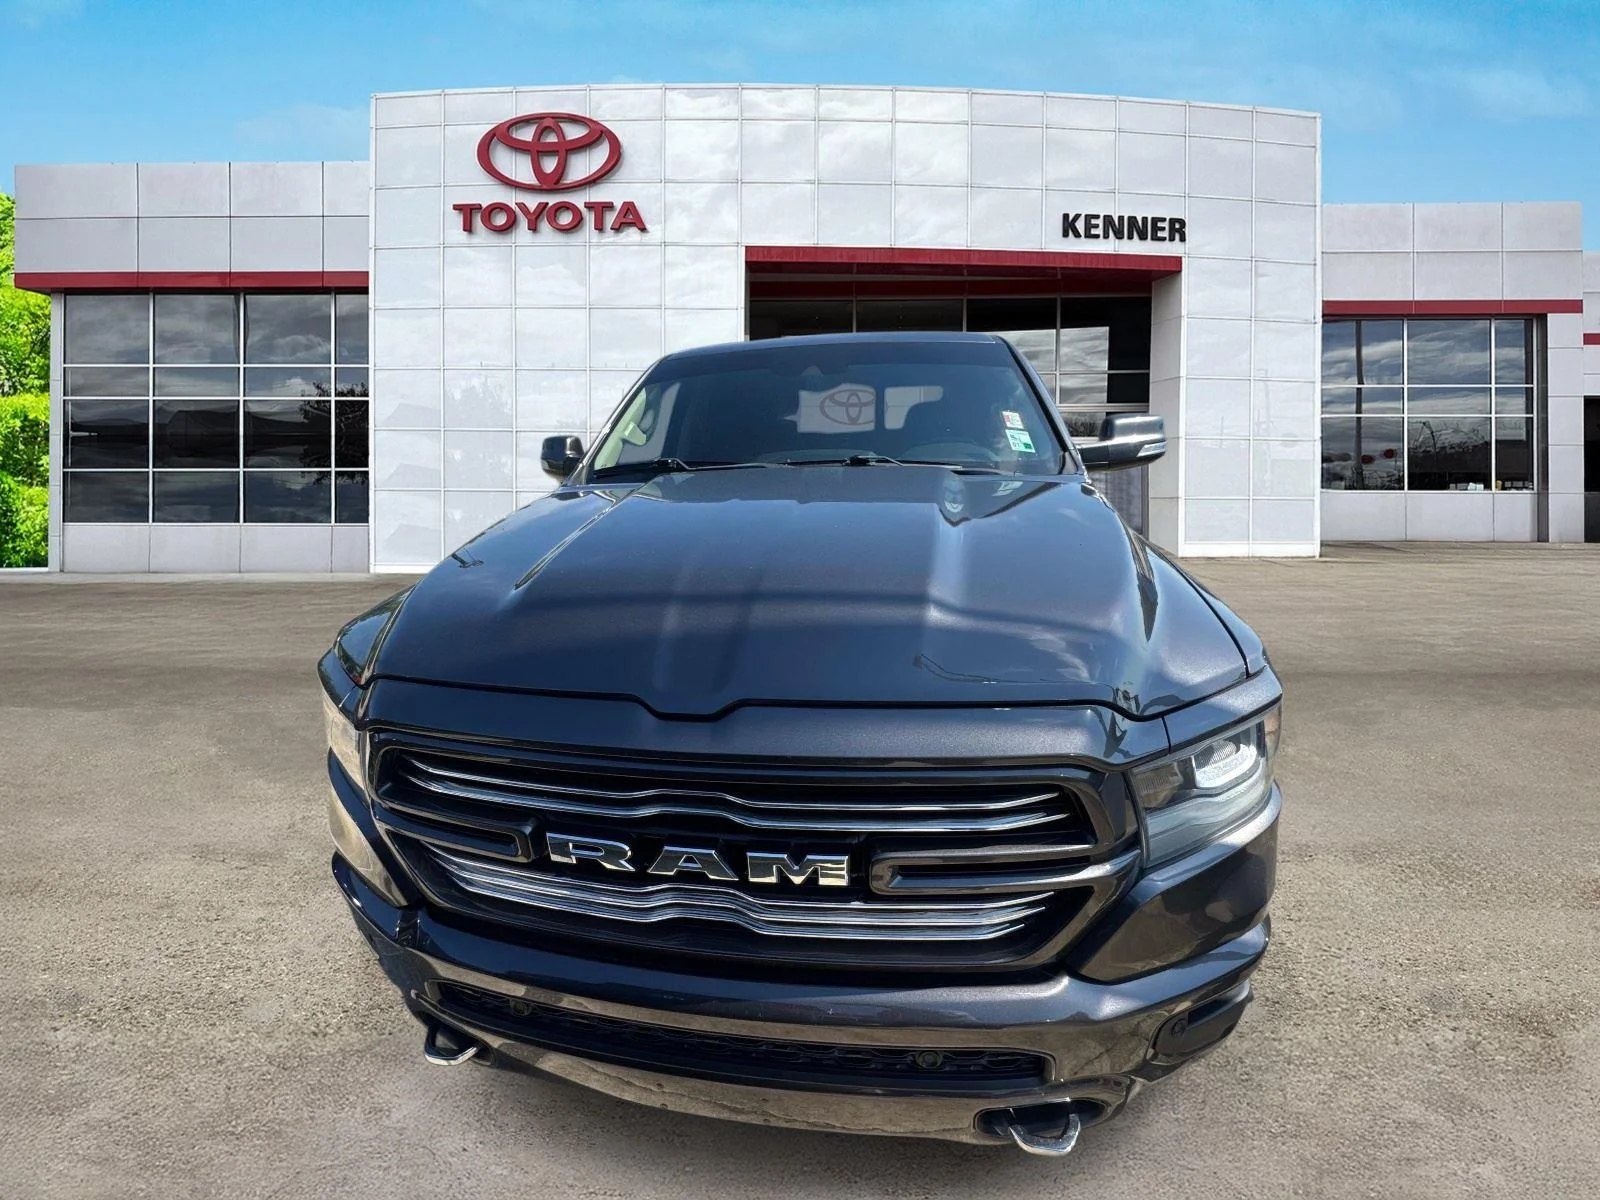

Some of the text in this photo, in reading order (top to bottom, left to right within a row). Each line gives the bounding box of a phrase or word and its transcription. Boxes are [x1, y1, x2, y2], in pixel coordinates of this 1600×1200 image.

[452, 201, 647, 232] TOYOTA
[1062, 213, 1187, 242] KENNER
[546, 832, 849, 886] RAM
